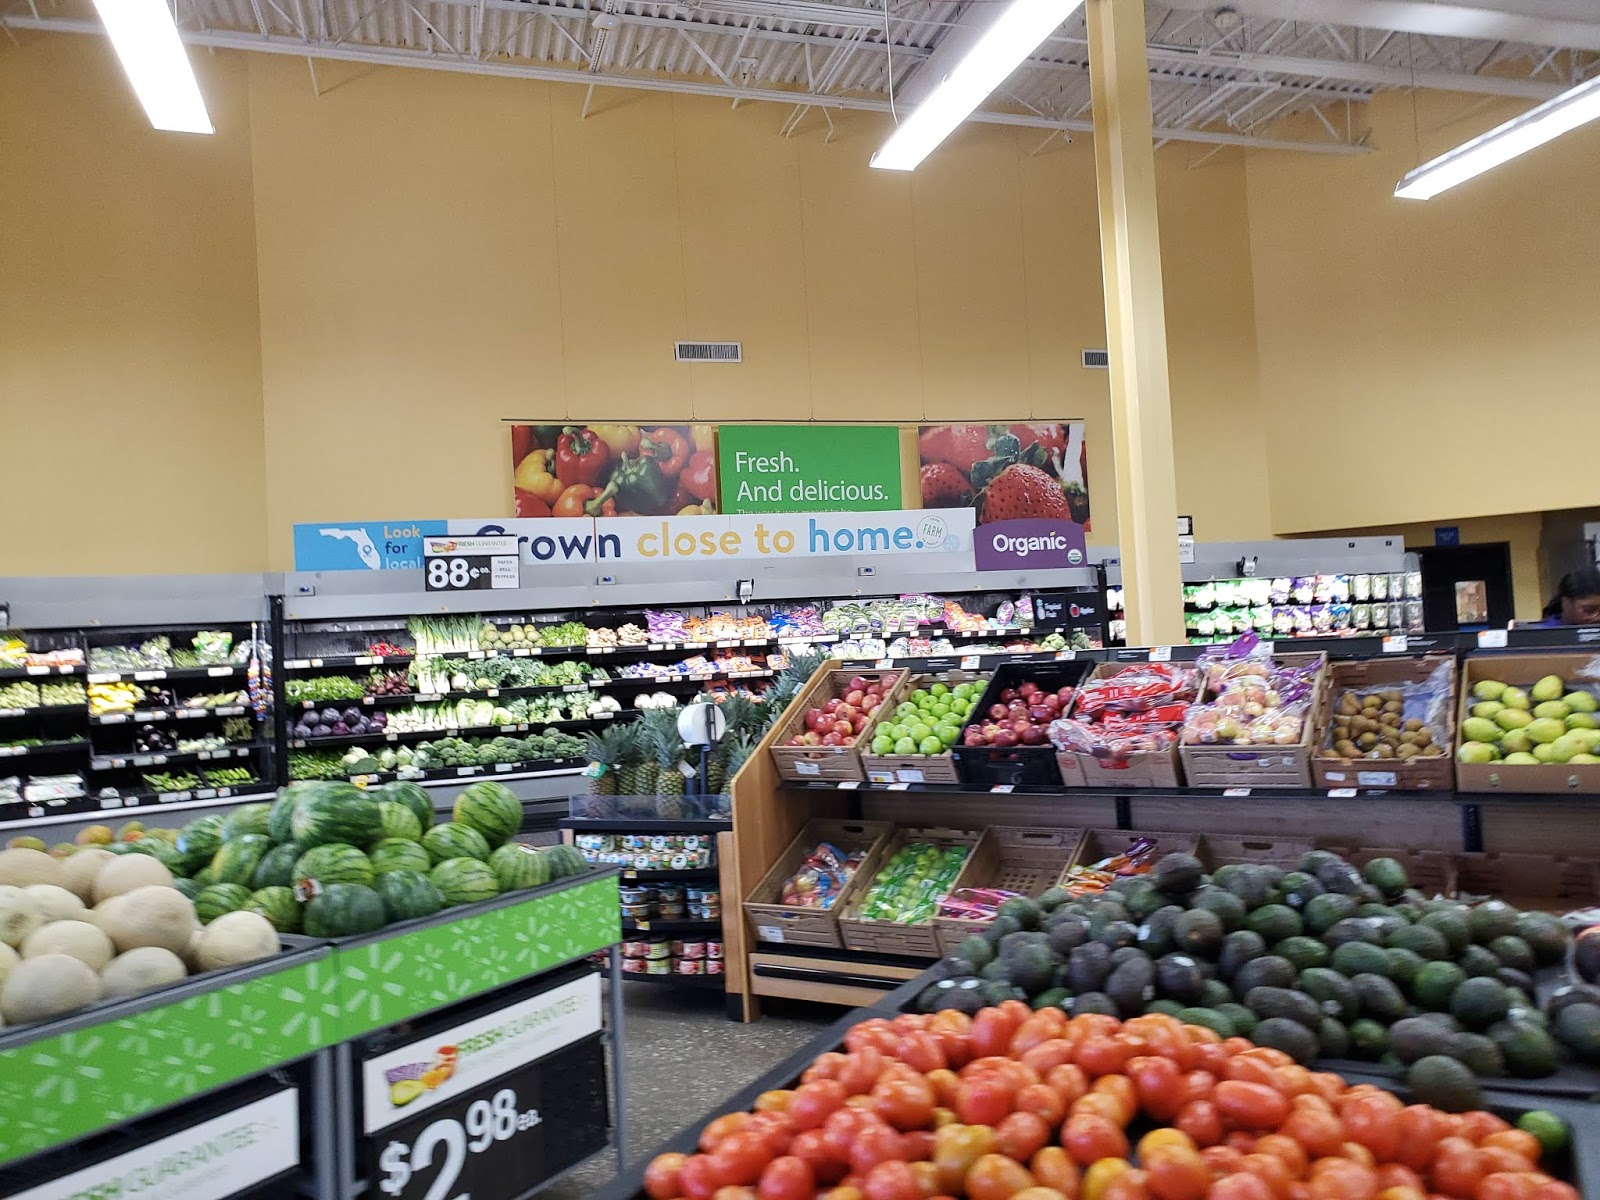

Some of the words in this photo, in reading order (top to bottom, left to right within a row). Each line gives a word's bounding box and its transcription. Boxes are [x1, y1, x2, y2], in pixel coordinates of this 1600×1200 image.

[735, 451, 800, 473] Fresh.
[736, 479, 783, 502] And
[789, 479, 889, 501] delicious.
[384, 524, 421, 539] Look
[637, 521, 742, 557] close
[754, 523, 795, 554] to
[809, 518, 924, 552] home.
[922, 523, 943, 538] FARM
[385, 541, 408, 554] for
[993, 531, 1068, 557] Organic
